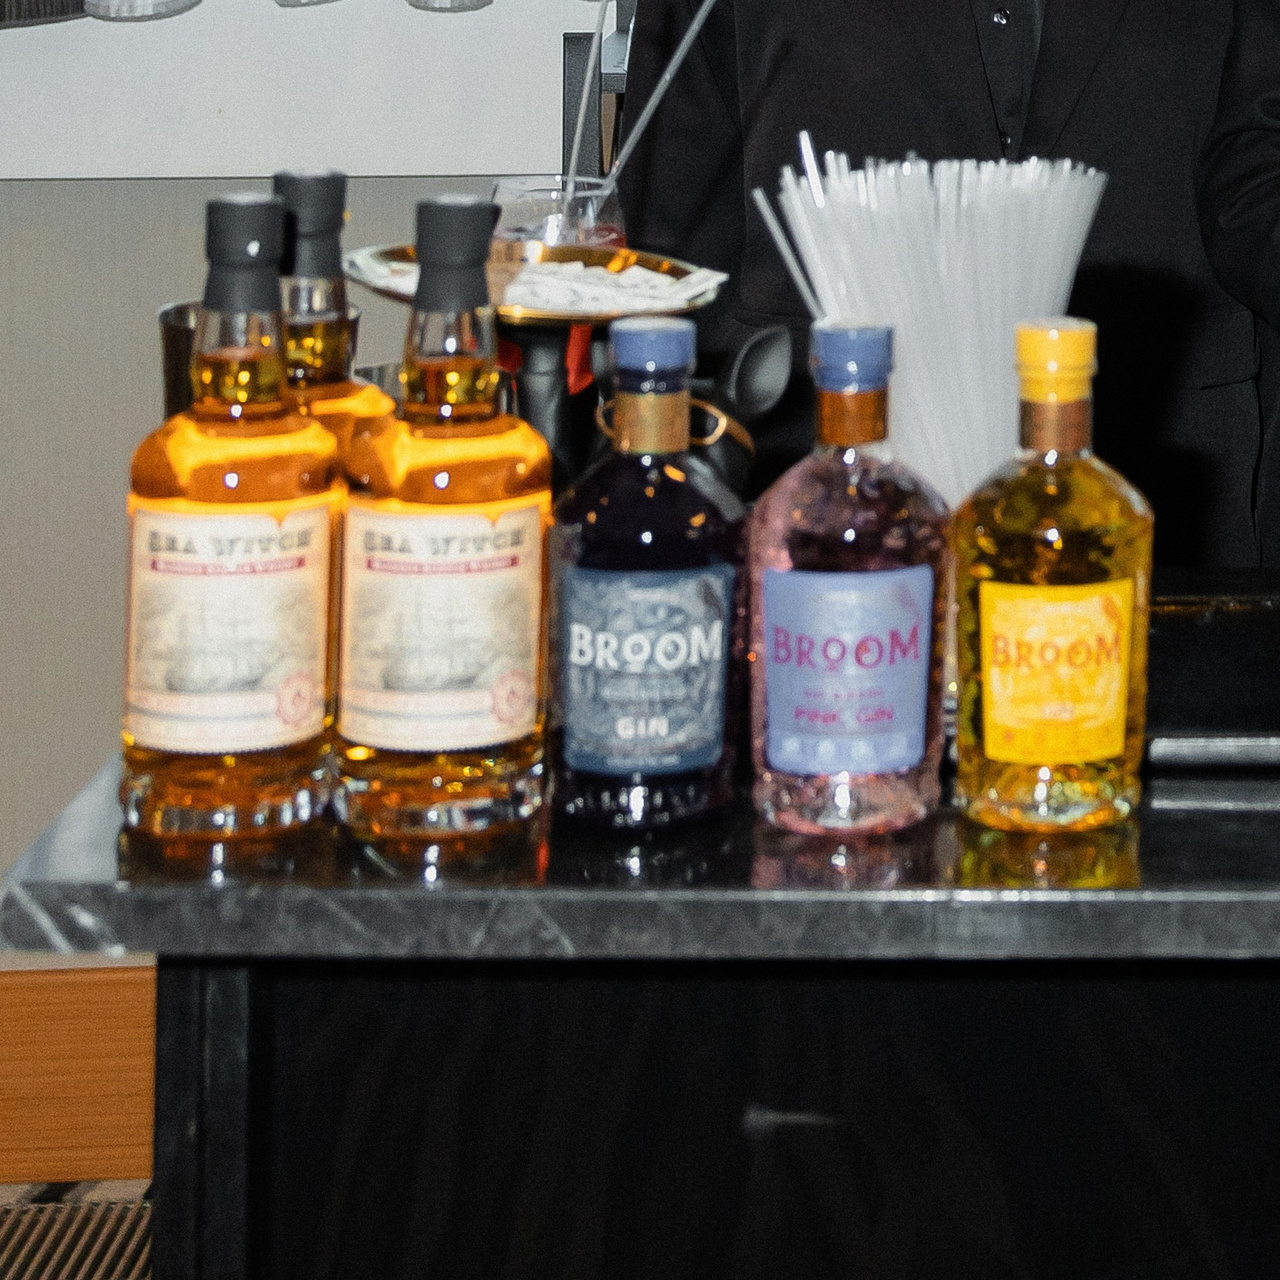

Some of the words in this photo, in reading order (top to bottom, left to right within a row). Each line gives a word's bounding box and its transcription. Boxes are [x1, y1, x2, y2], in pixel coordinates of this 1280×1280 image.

[569, 620, 723, 671] BROOM
[772, 623, 921, 672] BROOM
[992, 633, 1120, 672] BROOM
[615, 717, 669, 739] GIN
